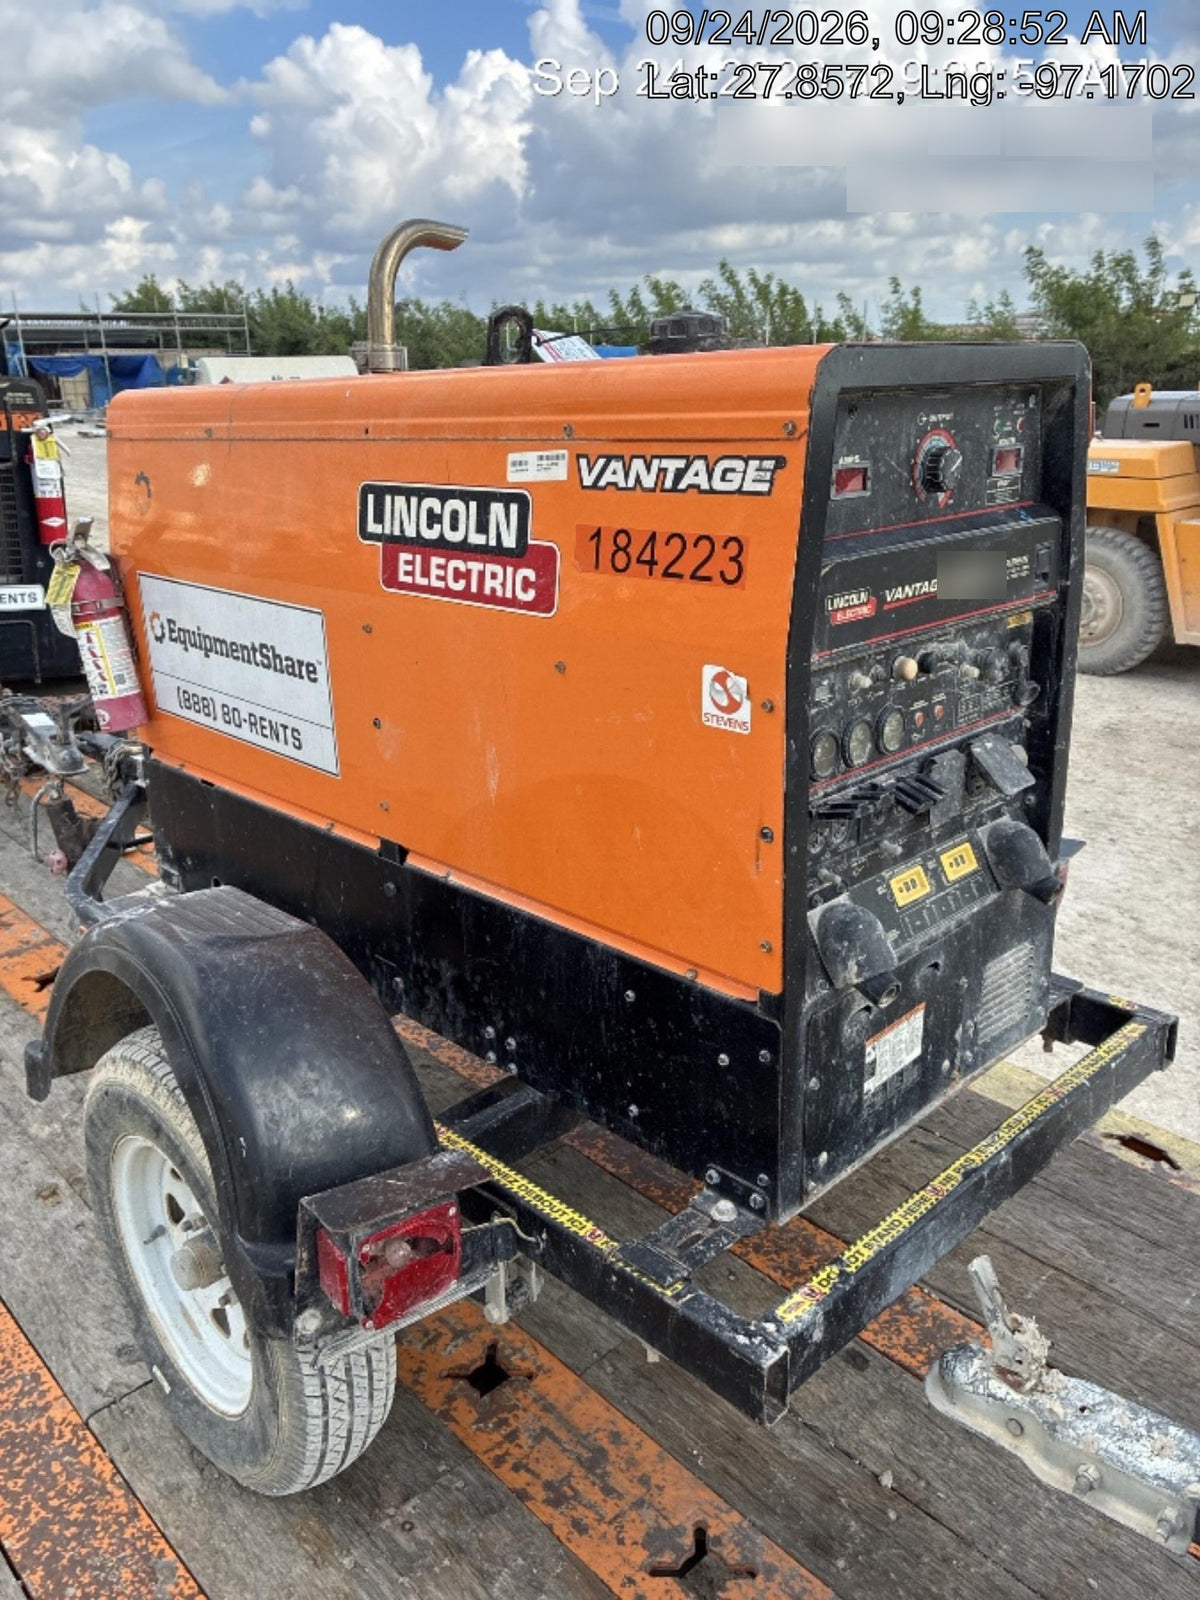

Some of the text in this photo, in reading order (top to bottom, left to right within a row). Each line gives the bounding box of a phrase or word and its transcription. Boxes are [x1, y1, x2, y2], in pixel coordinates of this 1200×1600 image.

[577, 456, 776, 494] VANTAGE
[366, 493, 519, 549] LINCOLN
[398, 552, 537, 602] ELECTRIC
[589, 526, 744, 586] 184223
[827, 590, 870, 611] LINCOLN
[884, 578, 938, 602] VANTAG
[166, 617, 320, 684] EquipmentShare
[177, 685, 303, 751] (888) 80-RENTS
[703, 712, 749, 732] STEVENS
[517, 1182, 569, 1218] DEBOUT
[862, 1219, 902, 1251] STAND
[899, 1194, 932, 1220] HERE
